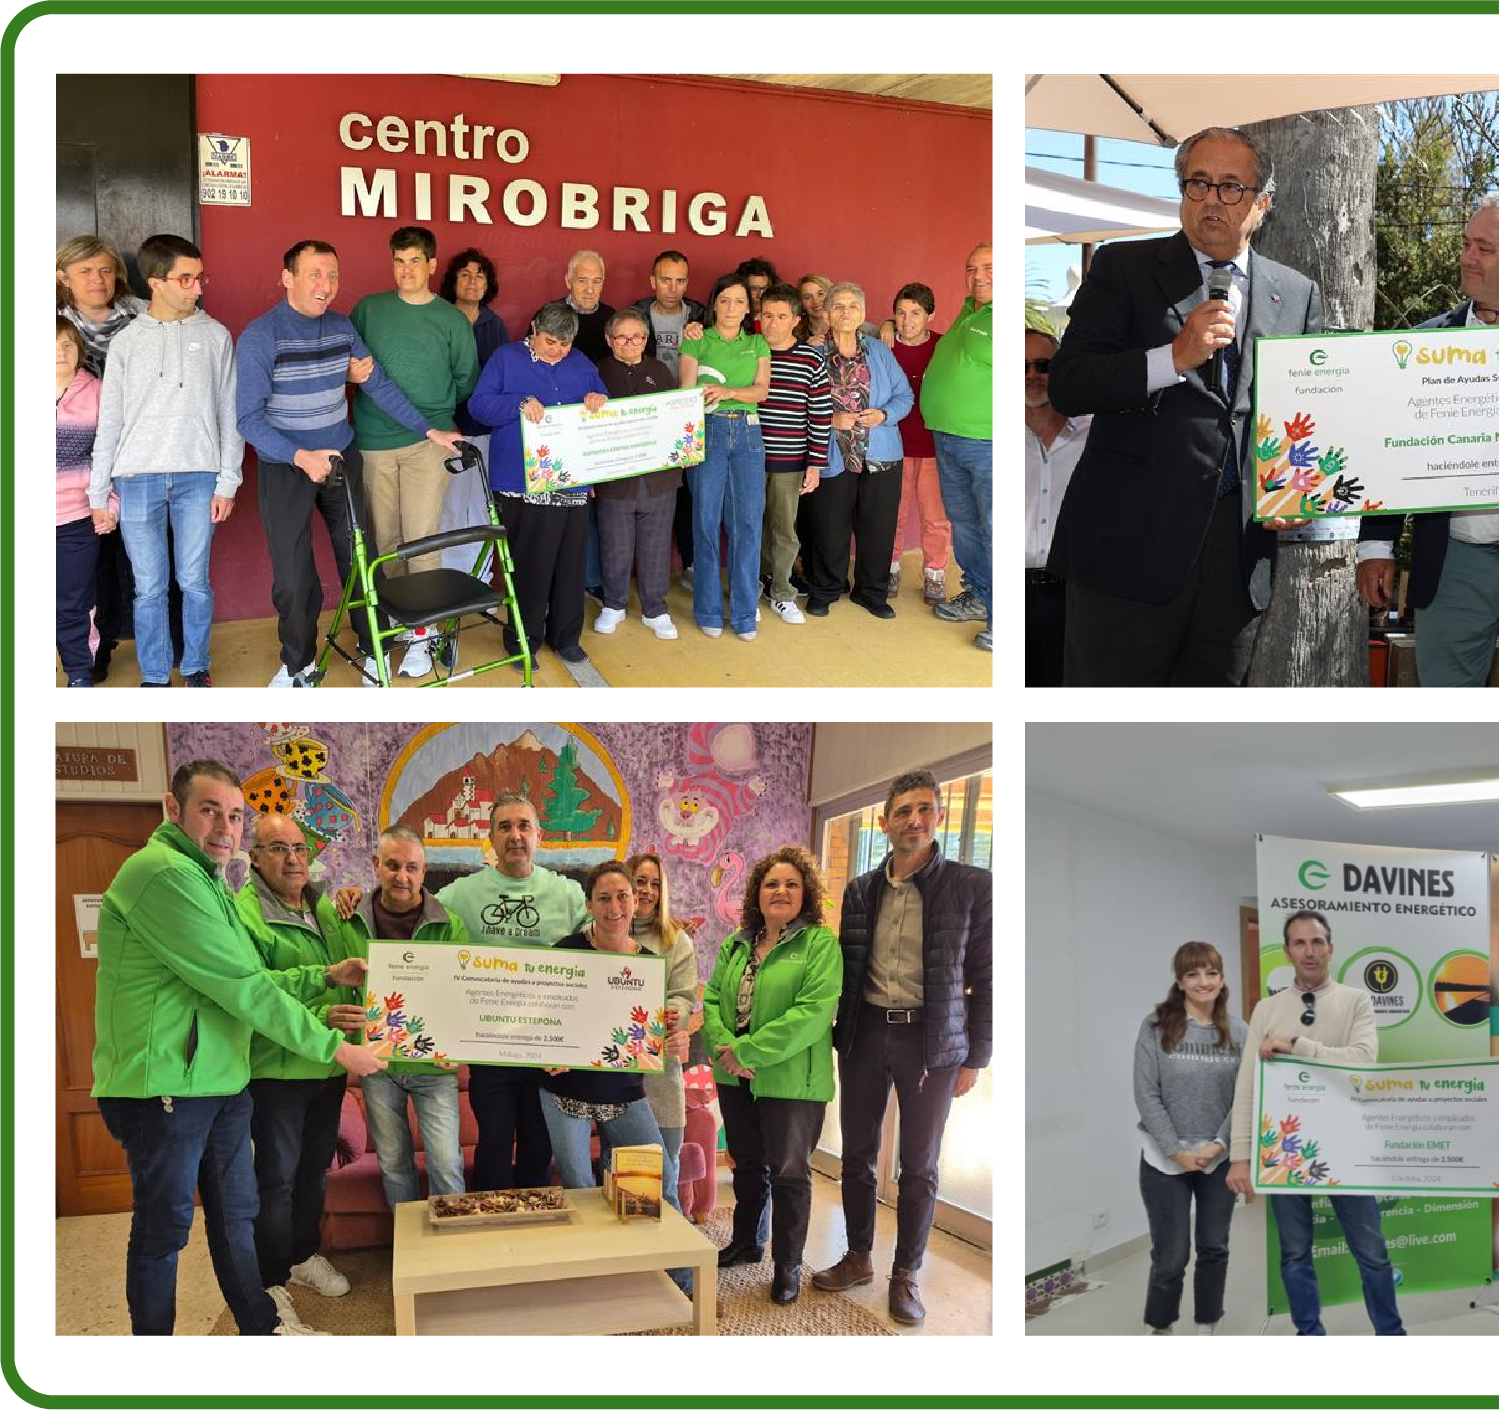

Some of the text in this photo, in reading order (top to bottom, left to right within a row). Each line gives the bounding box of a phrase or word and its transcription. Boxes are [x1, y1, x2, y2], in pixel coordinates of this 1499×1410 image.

[339, 113, 529, 164] centro
[340, 166, 774, 238] MIROBRIGA
[1416, 344, 1487, 365] suma
[1422, 376, 1442, 386] Plan
[1443, 376, 1456, 384] de
[1457, 374, 1490, 385] Ayudas
[1407, 396, 1452, 409] Agentes
[1414, 408, 1428, 419] de
[1430, 406, 1459, 419] Fenie
[1384, 434, 1445, 448] Fundación
[1447, 432, 1492, 445] Canaria
[1427, 458, 1479, 471] haciéndole
[1343, 863, 1455, 898] DAVINES
[1270, 897, 1476, 917] ASESORAMIENTO ENERGÉTICO
[473, 956, 518, 972] suma
[524, 962, 535, 973] tu
[479, 1014, 562, 1026] UBUNTU ESTEPONA
[1365, 1077, 1485, 1094] suma tu energía
[1361, 1113, 1390, 1122] Agentes
[1391, 1113, 1431, 1123] Energéticos
[1438, 1113, 1475, 1123] empleados
[1422, 1123, 1456, 1131] colaboran
[1384, 1140, 1451, 1150] Fundación EMET
[1406, 1155, 1430, 1164] entrega
[1424, 1199, 1479, 1213] Dimensión
